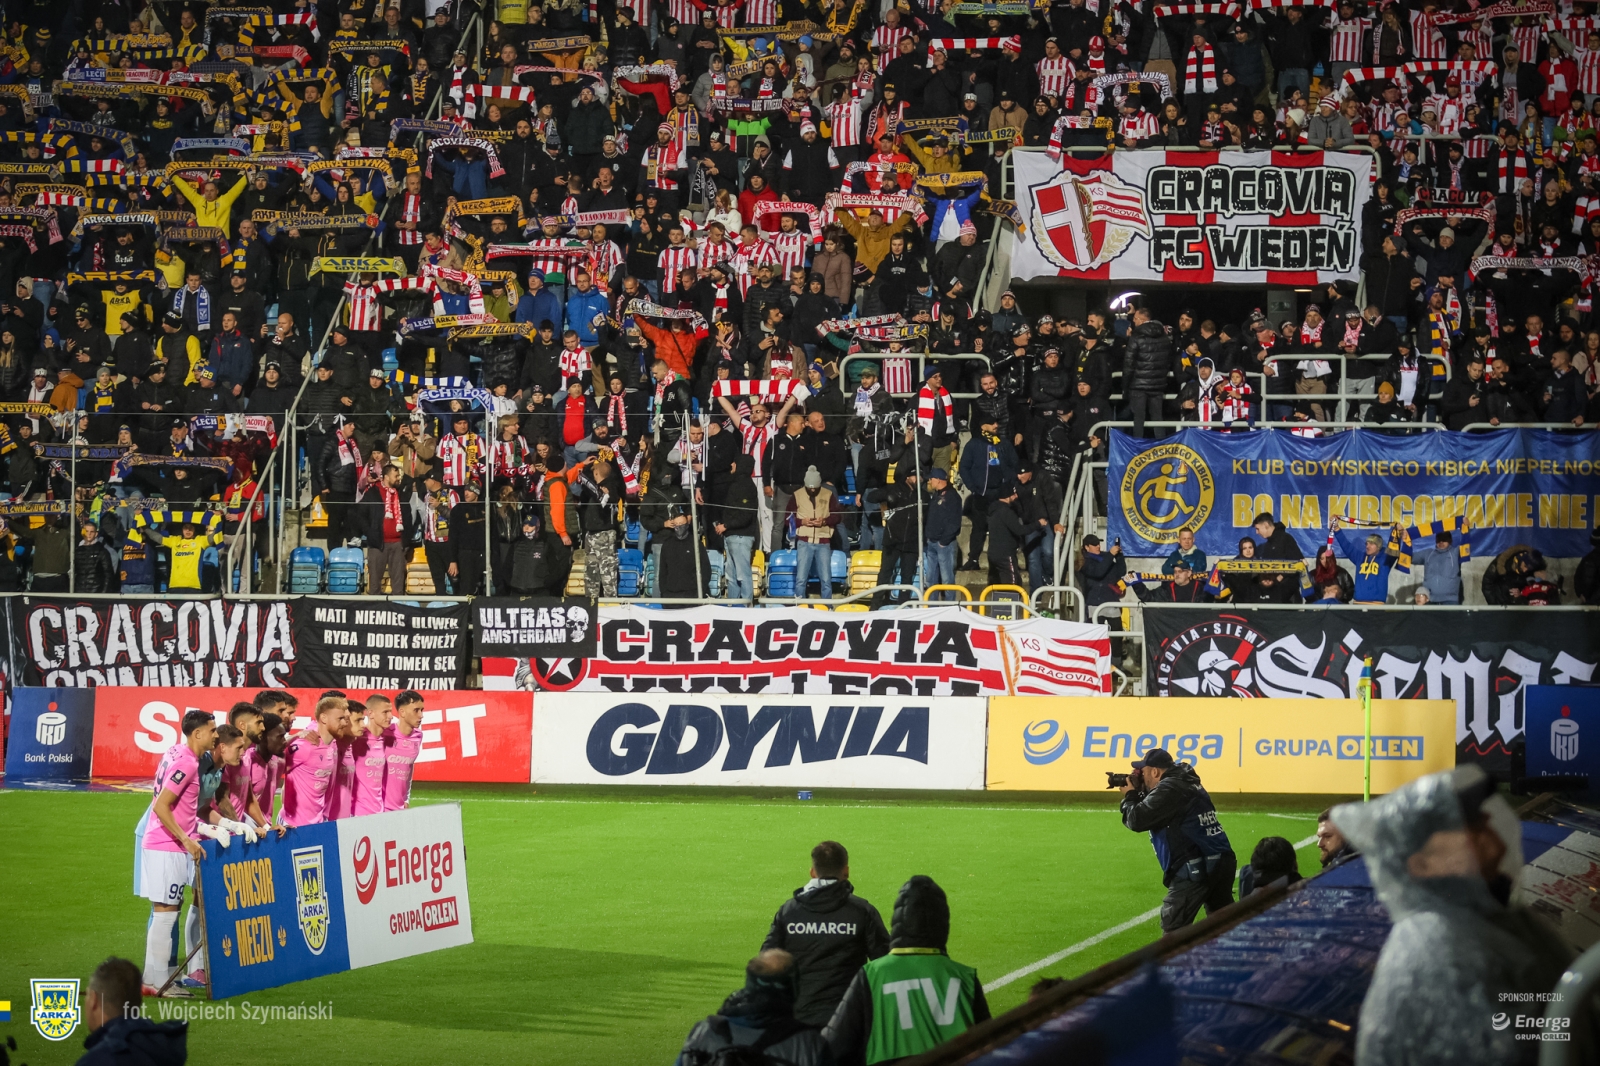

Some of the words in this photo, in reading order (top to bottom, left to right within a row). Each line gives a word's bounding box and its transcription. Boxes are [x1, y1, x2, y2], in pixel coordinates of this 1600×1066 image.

[126, 71, 149, 79] CRACOVIA
[967, 132, 993, 142] ARKA
[27, 164, 50, 173] ARKA
[1090, 187, 1104, 197] KS
[1150, 166, 1354, 217] CRACOVIA
[758, 201, 771, 211] KS
[1096, 204, 1141, 219] CRACOVIA
[83, 216, 111, 225] ARKA
[115, 214, 155, 224] GDYNIA
[333, 217, 358, 225] PARK
[579, 210, 617, 221] CRACOVIA
[1152, 226, 1203, 269] FC
[1206, 221, 1354, 270] WIEDEŃ
[324, 259, 389, 267] ARKA
[67, 271, 156, 287] ARKA
[110, 297, 130, 305] ARKA
[436, 316, 456, 325] ARKA
[457, 313, 483, 322] CRACOVIA
[196, 418, 217, 427] LECH
[1232, 458, 1285, 475] KLUB
[1290, 455, 1420, 477] GDYŃSKIEGO
[1426, 459, 1491, 476] KIBICA
[1124, 467, 1137, 492] KLUB
[1191, 458, 1211, 491] KIBICA
[1280, 493, 1323, 530] NA
[1327, 492, 1534, 530] KIBICOWANIE
[1539, 494, 1588, 530] NIE
[1226, 560, 1297, 570] ŚLEDZIE
[315, 608, 347, 623] MATI
[355, 610, 405, 627] NIEMIEC
[479, 606, 566, 628] ULTRAS
[29, 600, 296, 670] CRACOVIA
[324, 629, 358, 646] RYBA
[367, 632, 408, 649] DODEK
[412, 633, 458, 649] ŚWIEŻY
[481, 628, 567, 644] AMSTERDAM
[602, 618, 978, 668] CRACOVIA
[1020, 637, 1041, 652] KS
[332, 652, 380, 669] SZAŁAS
[388, 655, 430, 671] TOMEK
[434, 655, 456, 672] SĘK
[1158, 630, 1200, 697] RACOVIA
[346, 674, 399, 690] WOJTAS
[407, 677, 457, 690] ZIELONY
[1028, 663, 1094, 684] CRACOVIA
[586, 702, 930, 777] GDYNIA
[1082, 726, 1223, 769] Energa
[1255, 738, 1333, 757] GRUPA
[1341, 738, 1420, 758] ORLEN
[25, 754, 46, 763] Bank
[48, 753, 73, 763] Polski
[385, 840, 453, 893] Energa
[223, 857, 275, 911] SPONSOR
[303, 904, 323, 918] ARKA
[390, 909, 422, 935] GRUPA
[424, 900, 457, 930] ORLEN
[787, 922, 857, 935] COMARCH
[235, 915, 275, 967] MECZU
[883, 977, 961, 1030] TV
